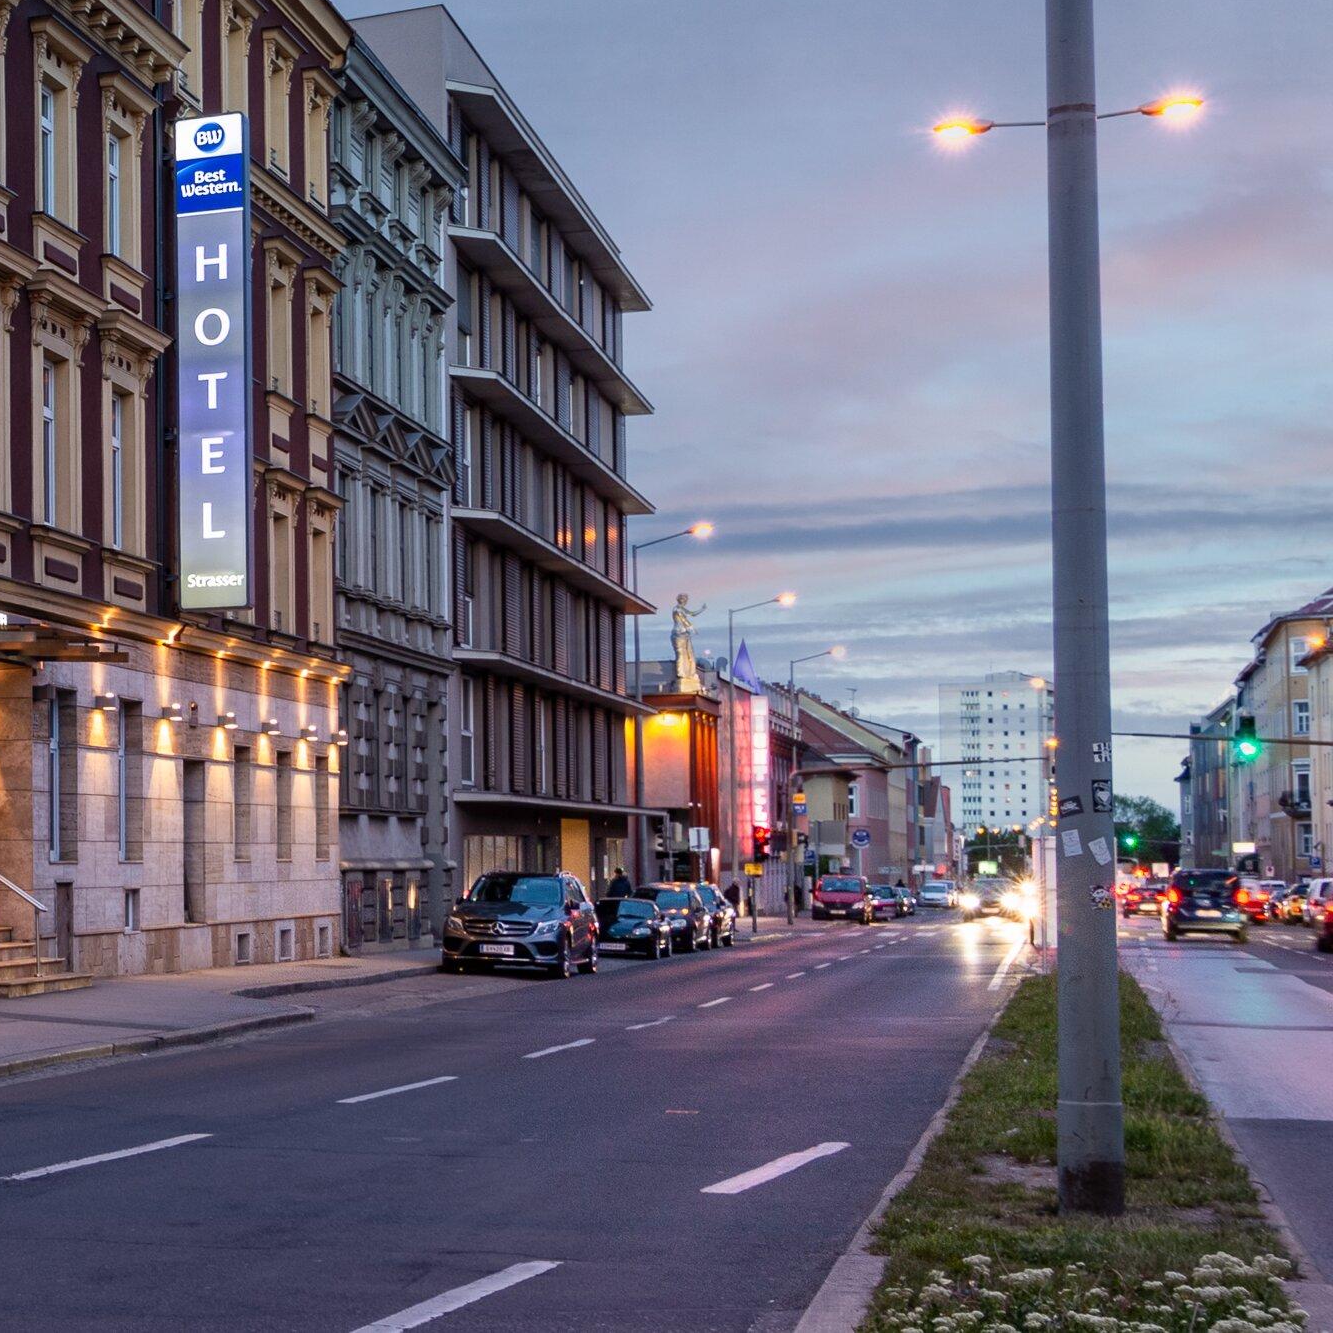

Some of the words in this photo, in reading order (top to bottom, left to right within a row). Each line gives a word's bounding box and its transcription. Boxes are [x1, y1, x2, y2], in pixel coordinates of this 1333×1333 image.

[196, 129, 223, 146] BW
[194, 169, 226, 184] Best
[194, 243, 231, 539] HOTEL
[187, 573, 245, 588] Strasser
